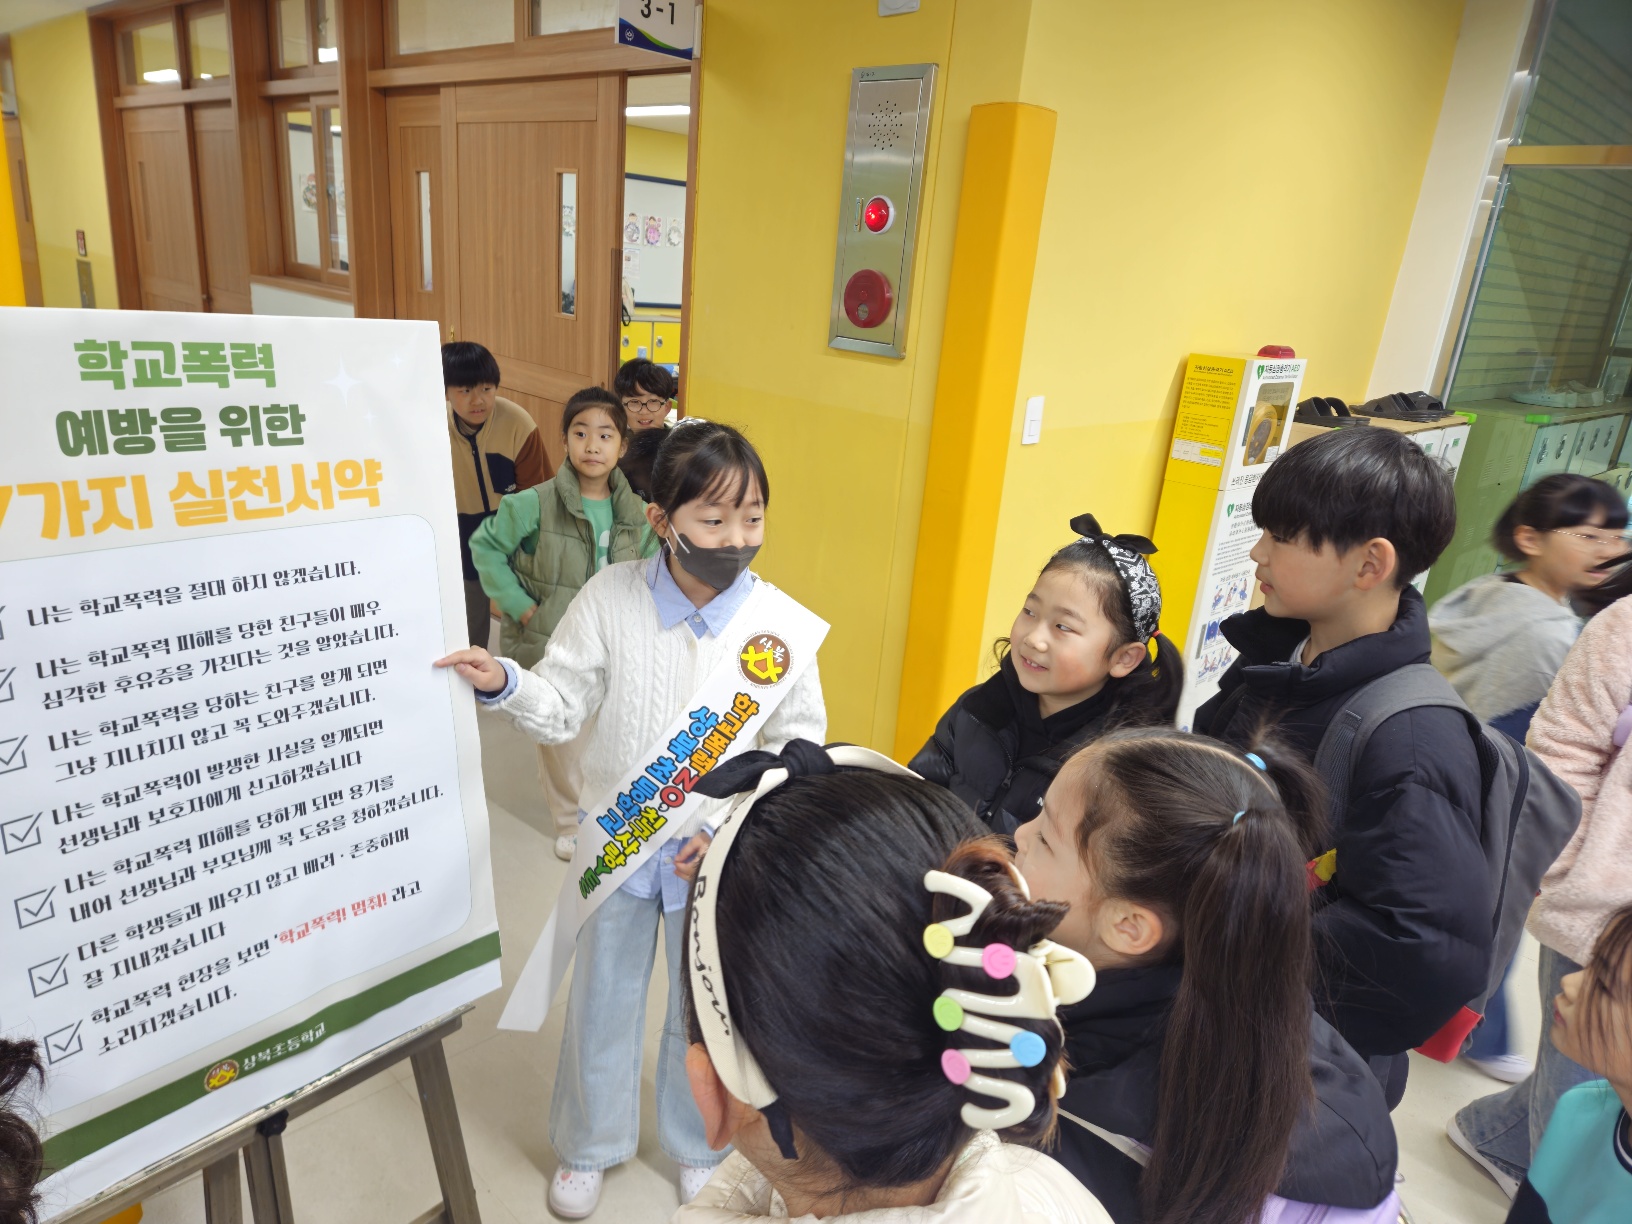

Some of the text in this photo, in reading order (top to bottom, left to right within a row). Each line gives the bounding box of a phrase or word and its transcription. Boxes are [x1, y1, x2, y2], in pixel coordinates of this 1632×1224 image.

[640, 0, 675, 25] 3-1
[73, 339, 277, 390] 학교폭력
[55, 404, 306, 457] 예방을 위한
[169, 458, 383, 528] 실천서약
[27, 560, 361, 627] 나는 학교폭력을 절대 하지 않겠습니다.
[35, 600, 382, 679] 나는 학교폭력 피해를 당한 친구들이 매우
[41, 623, 399, 710] 심각한 후유증을 가진다는 것을 알았습니다.
[47, 658, 388, 751] 나는 학교폭력을 당하는 친구를 알게 되면
[55, 687, 376, 783] 그냥 지나치지 않고 꼭 도와주겠습니다.
[51, 719, 384, 825] 나는 학교폭력이 발생한 사실을 알게되면
[58, 750, 363, 855] 선생님과 보호자에게 신고하겠습니다
[596, 705, 719, 837] 상북초등학교
[64, 774, 395, 894] 나는 학교폭력 피해를 당하게 되면 용기를
[69, 784, 444, 923] 내어 선생님과 부모님께 꼭 도움을 청하겠습니다.
[77, 932, 120, 961] 다른
[125, 902, 204, 940] 학생들과
[208, 880, 261, 912] 싸우지
[265, 866, 299, 890] 않고
[303, 852, 335, 876] 배려
[349, 827, 410, 859] 존중하며
[82, 921, 226, 989] 잘 지내겠습니다
[91, 982, 173, 1024] 학교폭력
[178, 957, 231, 992] 현장을
[237, 939, 271, 967] 보면
[351, 892, 387, 917] 멈춰!
[391, 880, 423, 902] 라고
[98, 984, 237, 1056] 소리치겠습니다.
[242, 1022, 326, 1071] 상북초등학교
